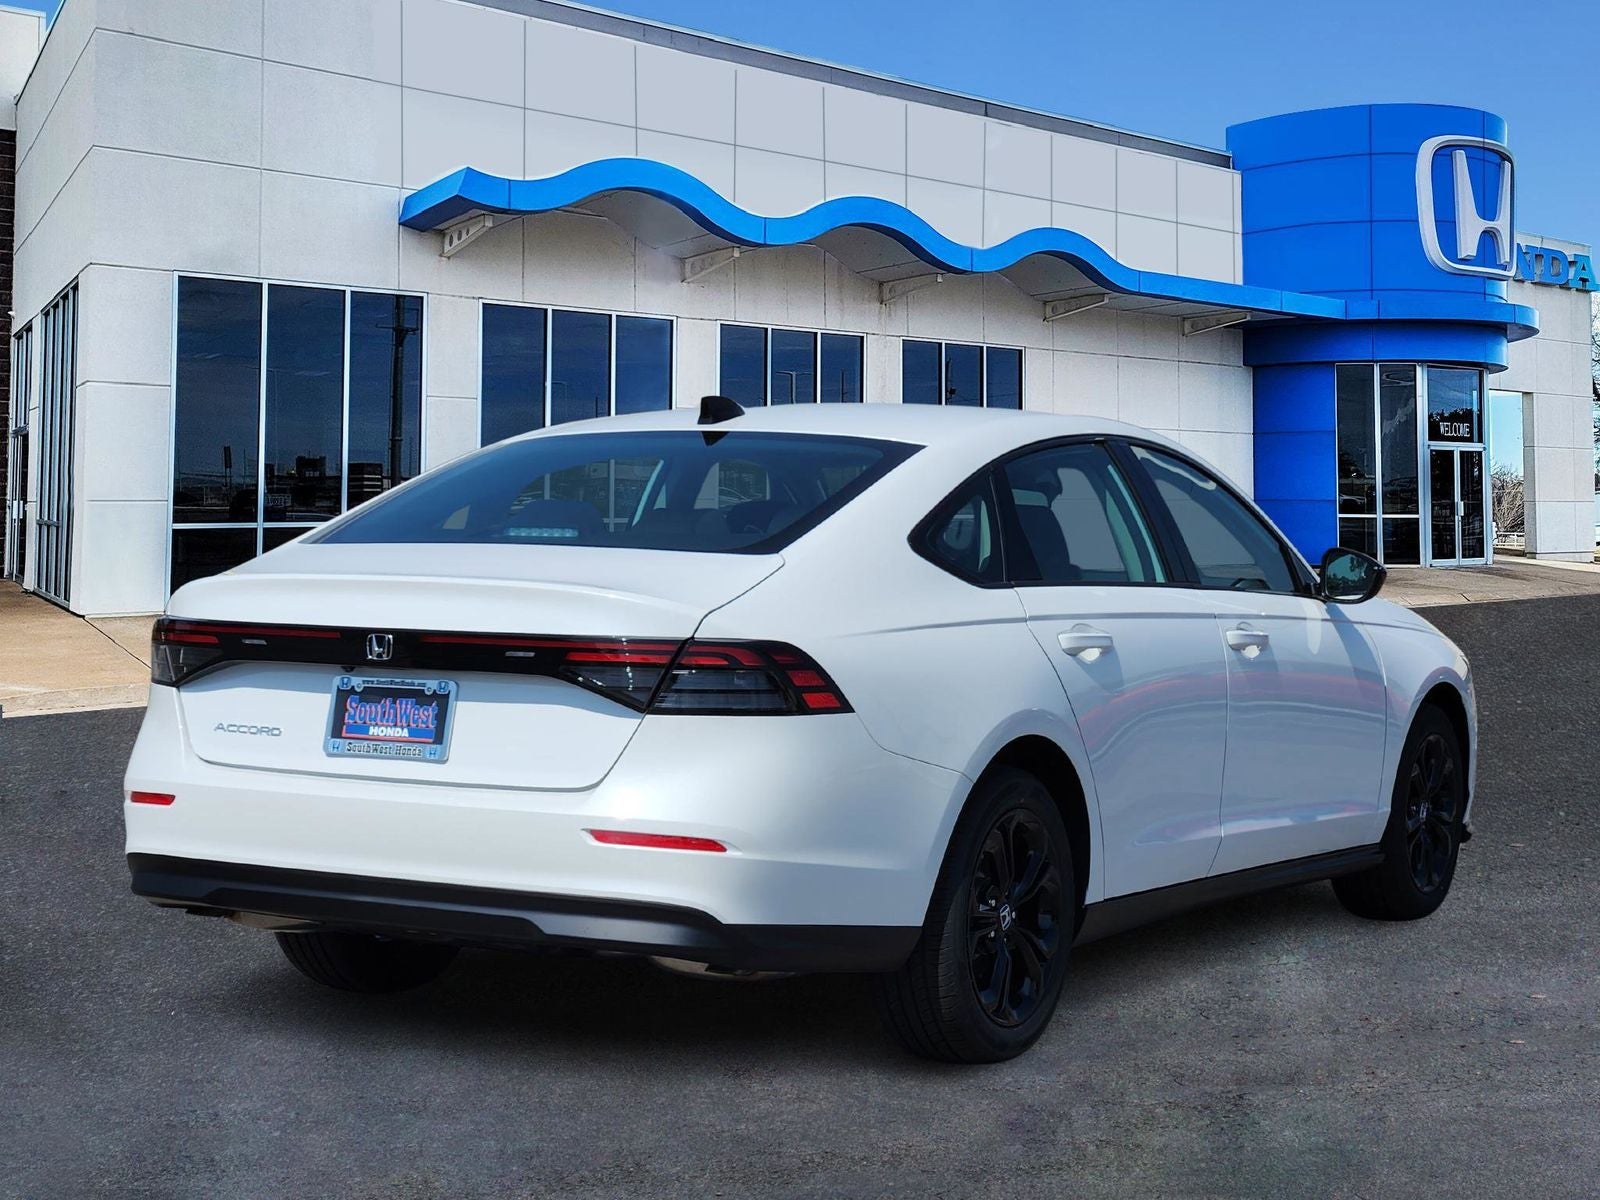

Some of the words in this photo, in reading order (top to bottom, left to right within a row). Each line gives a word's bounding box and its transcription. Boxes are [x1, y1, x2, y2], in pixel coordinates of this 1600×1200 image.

[1514, 243, 1600, 291] NDA
[1439, 421, 1471, 437] WELCOME
[344, 695, 438, 728] SouthWest
[213, 722, 282, 737] ACCORD
[368, 726, 410, 738] HONDA
[346, 742, 393, 755] SouthWest
[395, 745, 423, 757] Honda
